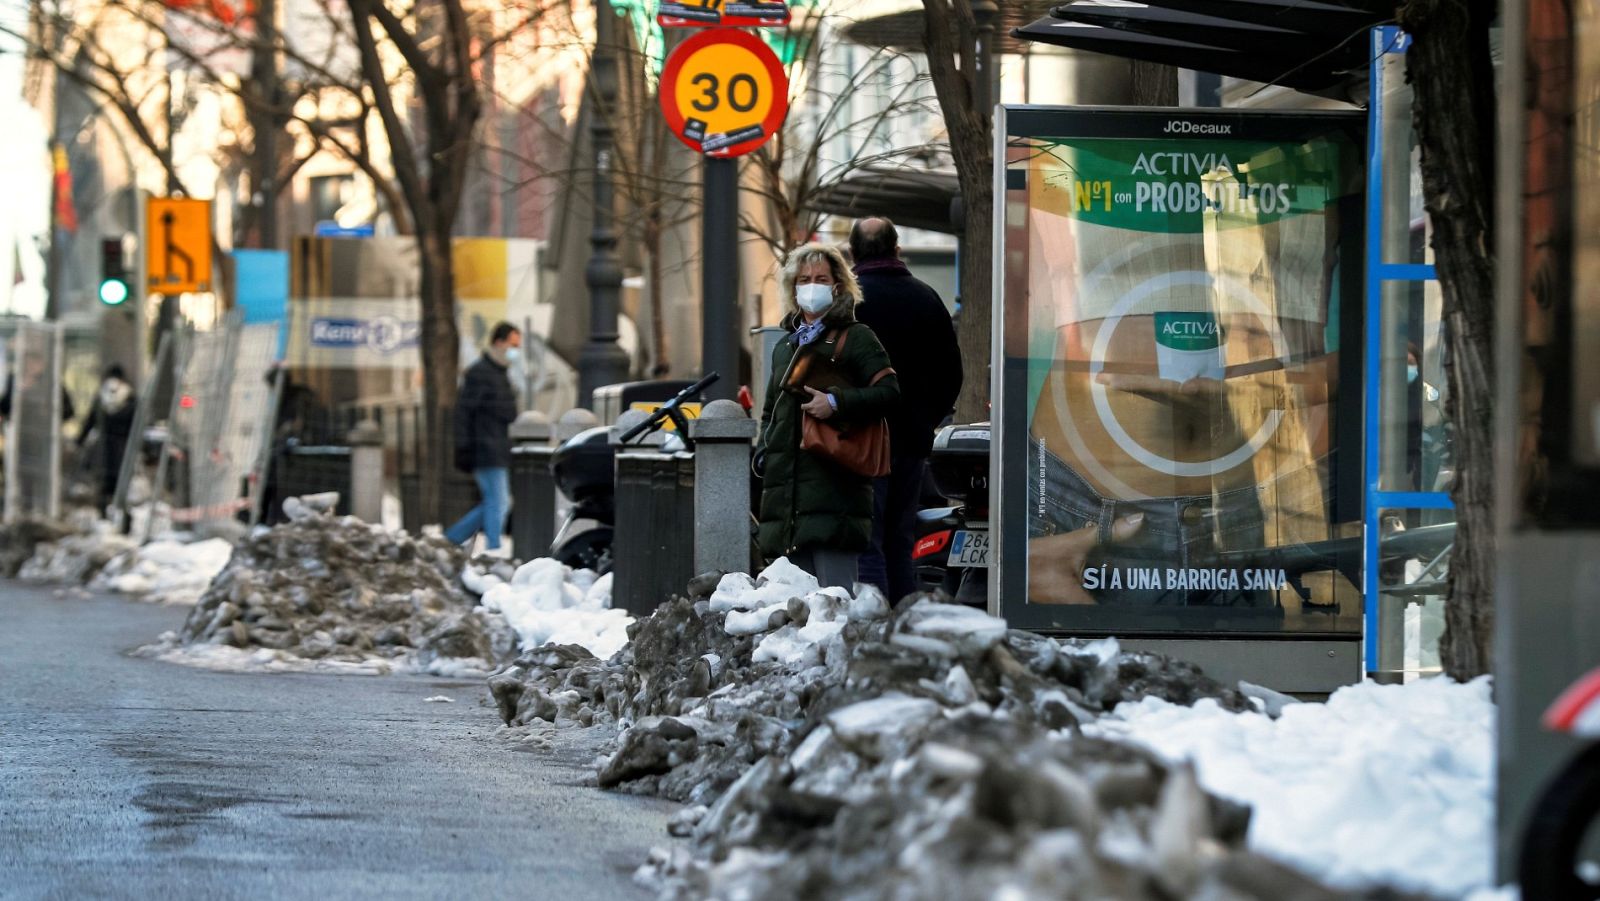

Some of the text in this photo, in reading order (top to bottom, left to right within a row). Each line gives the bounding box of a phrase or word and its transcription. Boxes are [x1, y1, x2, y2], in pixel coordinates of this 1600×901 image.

[691, 72, 758, 112] 30
[1163, 121, 1231, 134] JCDecaux
[1131, 152, 1235, 175] ACTIVIA
[1114, 192, 1132, 203] con
[1163, 321, 1221, 334] ACTIVIA
[960, 549, 988, 564] LCK
[1082, 564, 1288, 590] SÍ A UNA BARRIGA SANA
